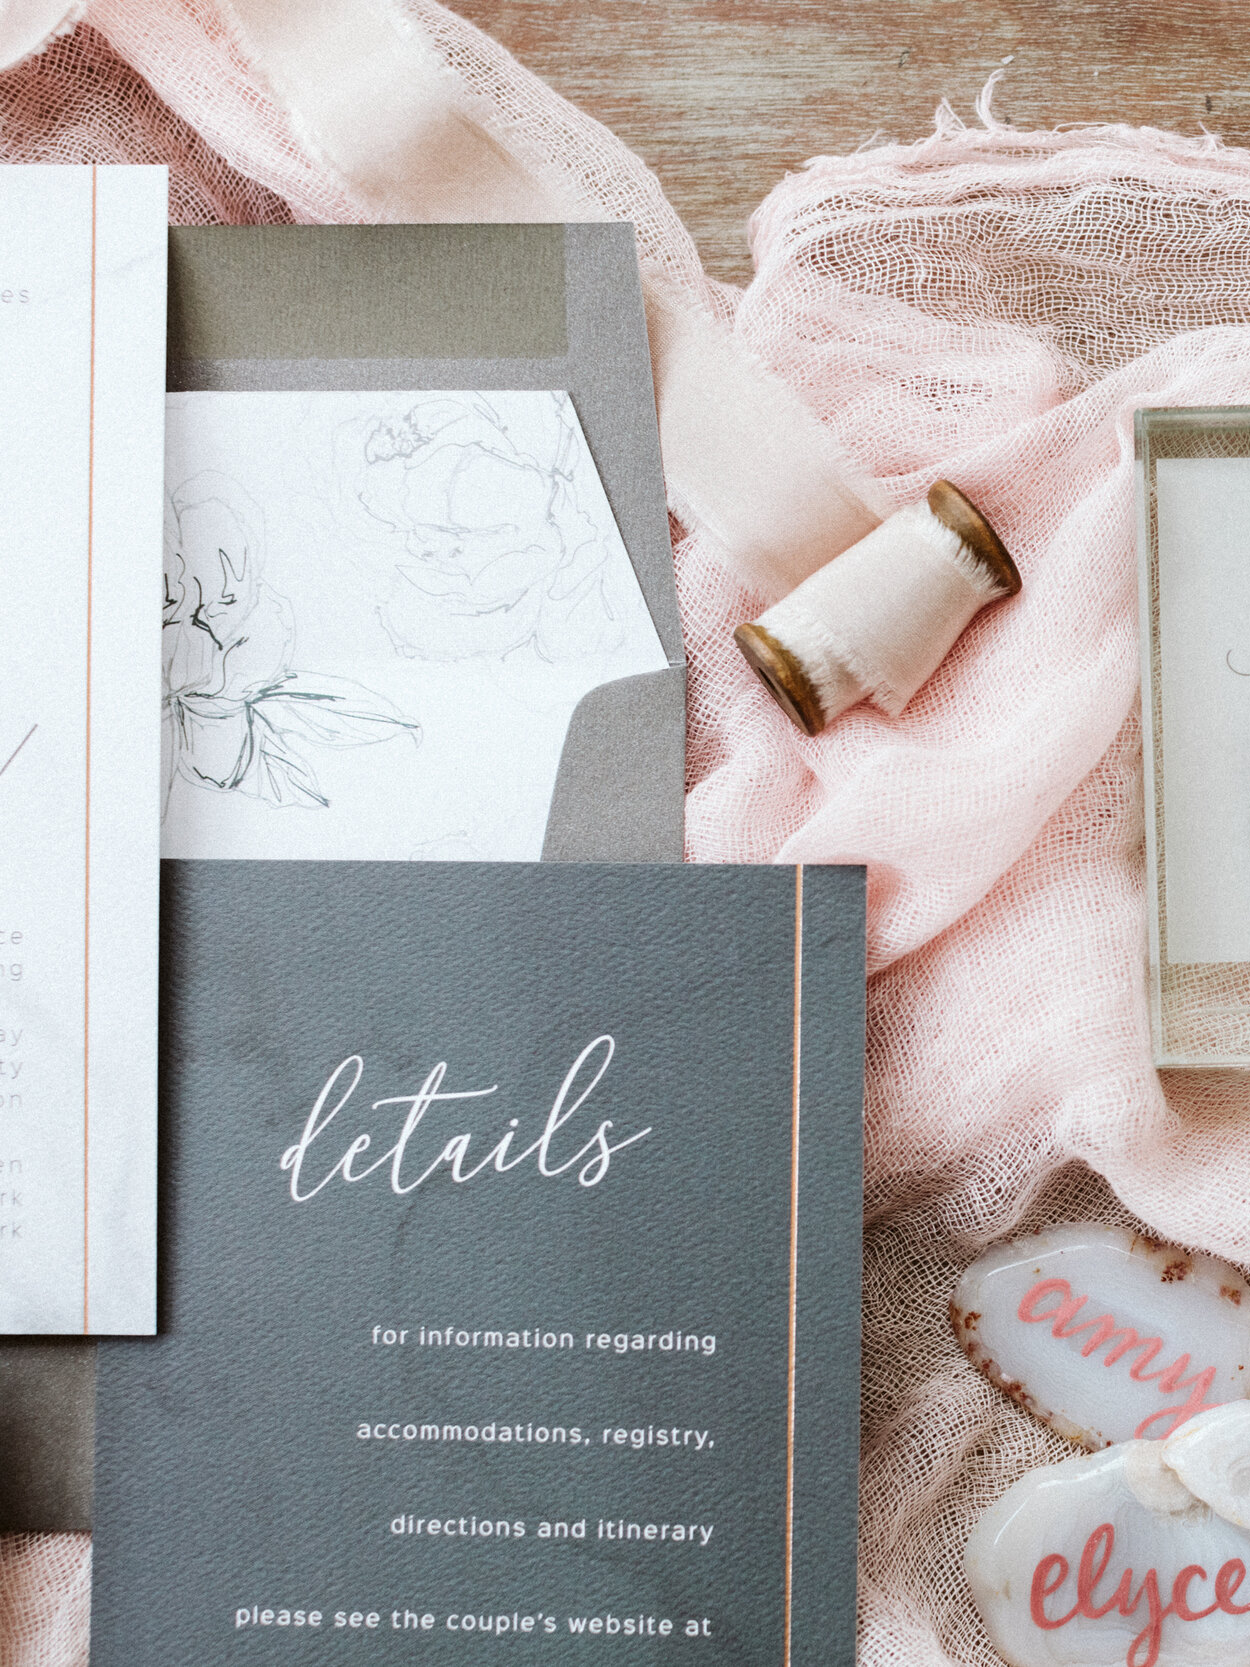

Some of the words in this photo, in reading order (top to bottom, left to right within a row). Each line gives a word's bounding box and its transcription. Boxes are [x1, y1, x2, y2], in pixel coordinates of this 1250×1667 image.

[279, 1034, 654, 1203] details
[372, 1325, 409, 1347] for
[419, 1327, 575, 1350] information
[586, 1330, 717, 1356] regarding
[1018, 1278, 1228, 1440] amy
[356, 1421, 592, 1447] accommodations,
[603, 1426, 716, 1451] registry,
[390, 1515, 527, 1539] directions
[537, 1519, 587, 1540] and
[598, 1520, 715, 1546] itinerary
[235, 1605, 323, 1630] please
[334, 1611, 381, 1630] see
[392, 1610, 436, 1631] the
[447, 1612, 558, 1637] couple's
[569, 1614, 674, 1638] website
[685, 1619, 712, 1638] at
